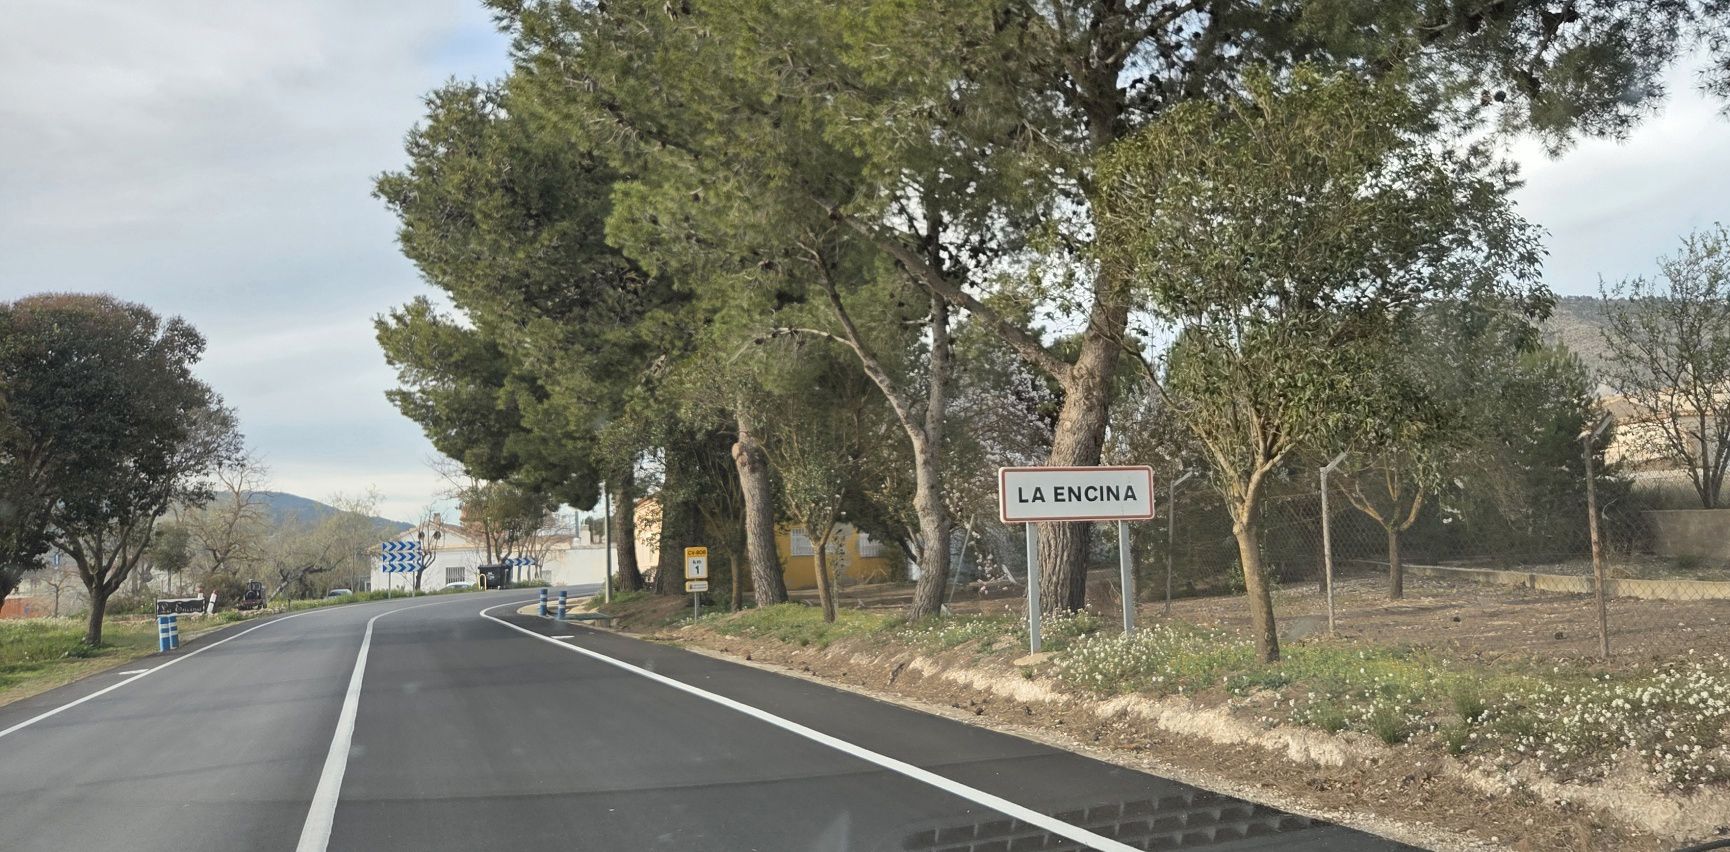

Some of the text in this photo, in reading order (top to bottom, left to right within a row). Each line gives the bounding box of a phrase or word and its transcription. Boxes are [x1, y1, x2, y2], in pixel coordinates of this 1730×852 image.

[1018, 485, 1137, 503] LA ENCINA
[695, 565, 699, 575] 1
